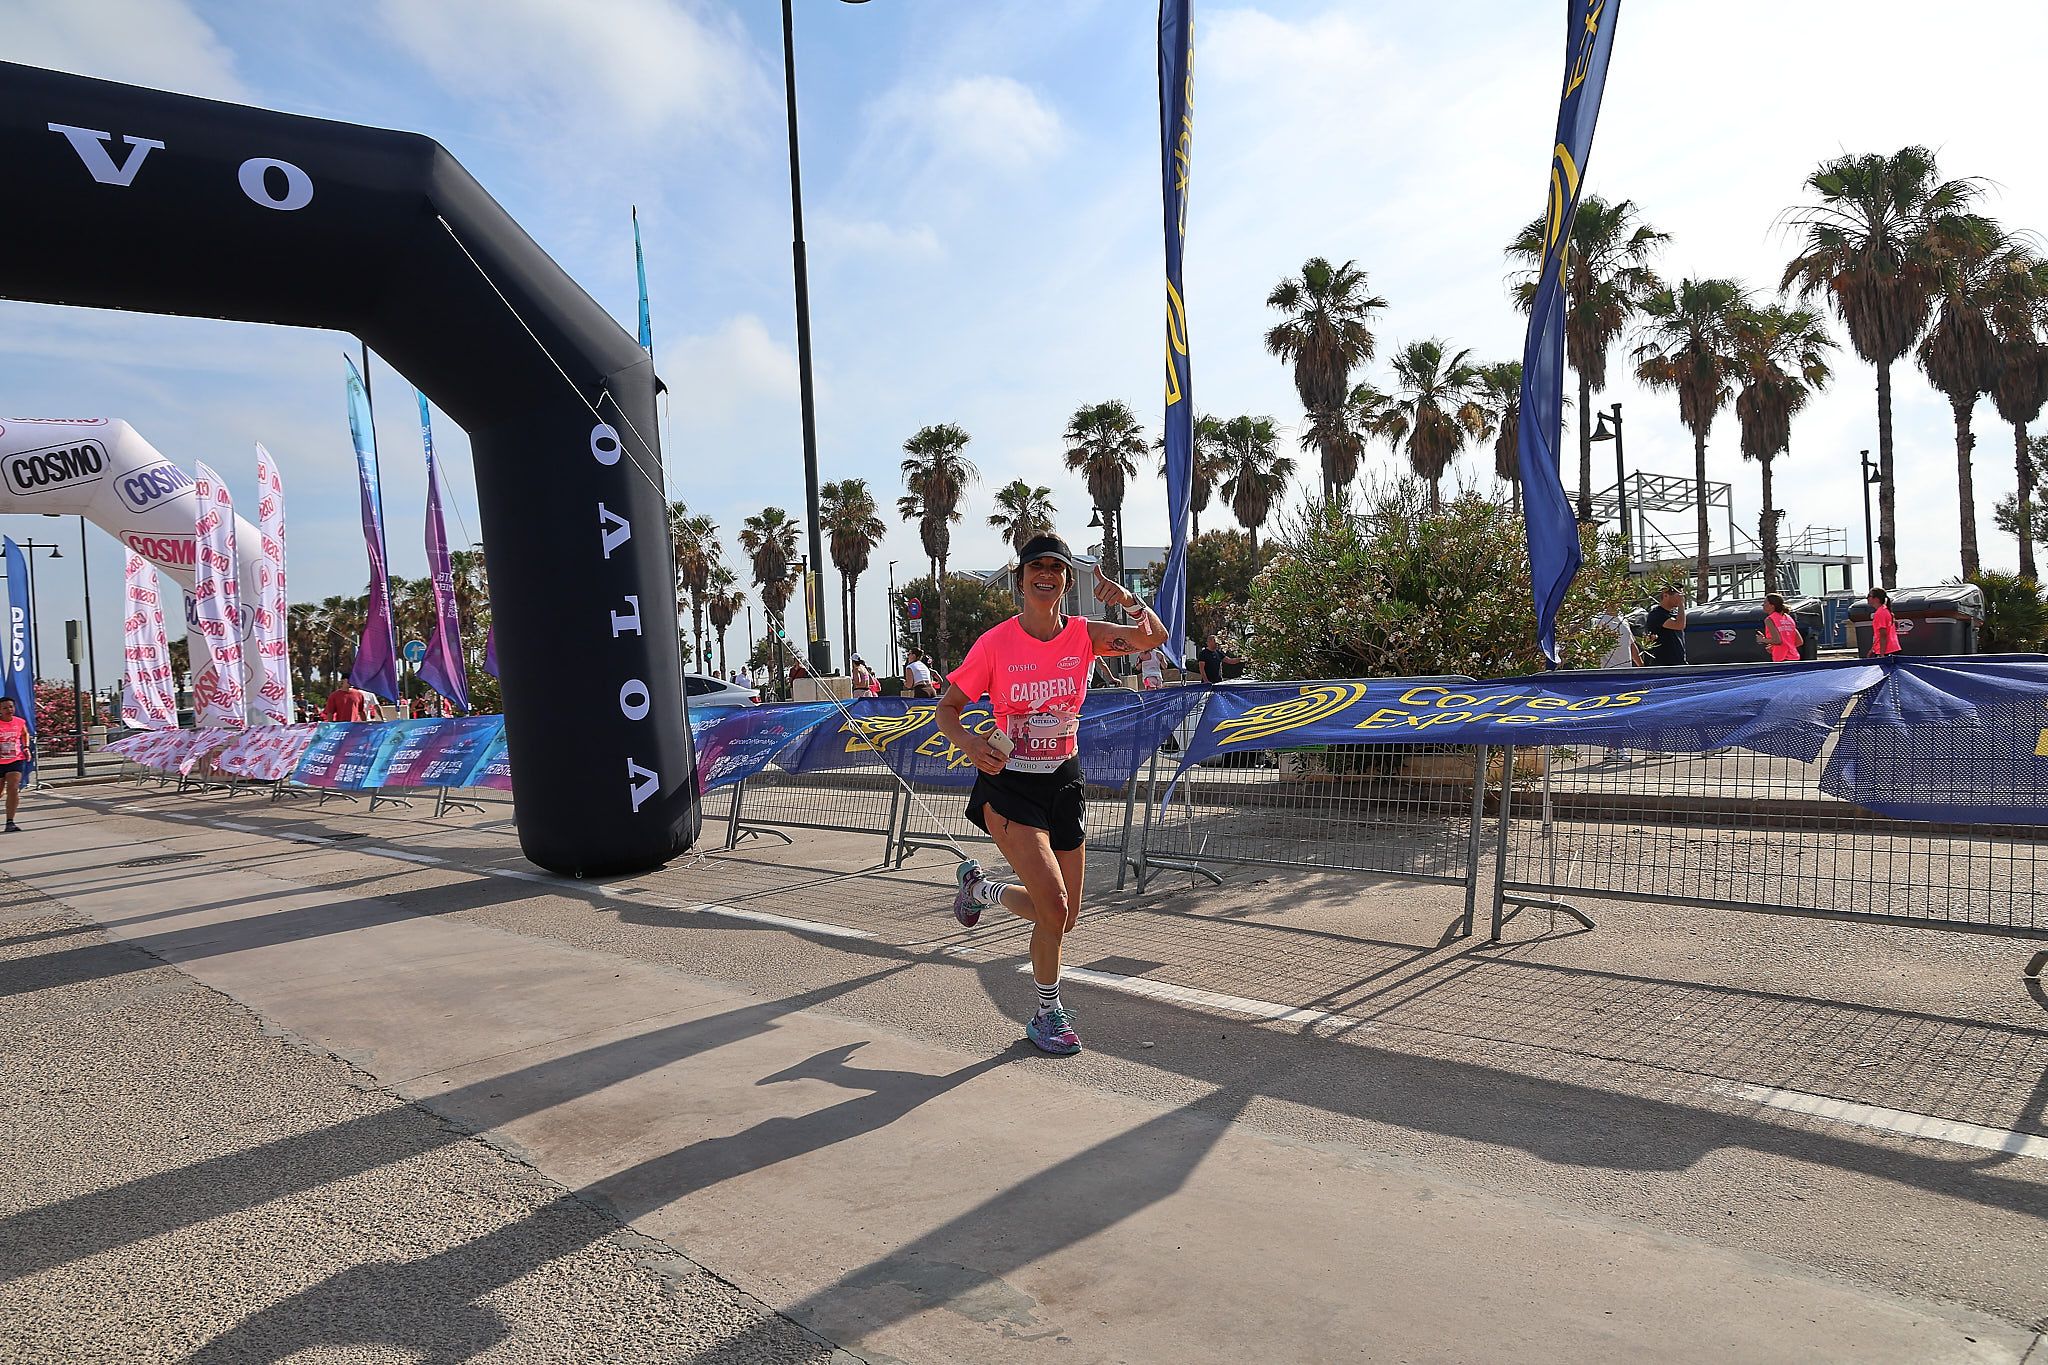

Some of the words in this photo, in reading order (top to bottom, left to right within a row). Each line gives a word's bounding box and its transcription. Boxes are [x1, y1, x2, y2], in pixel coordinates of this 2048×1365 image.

[12, 445, 103, 489] COSMO
[129, 535, 196, 565] COSM
[590, 423, 661, 813] VOLVO
[1008, 663, 1037, 673] OYSHO
[1399, 686, 1650, 711] Correos
[1030, 738, 1057, 749] 016
